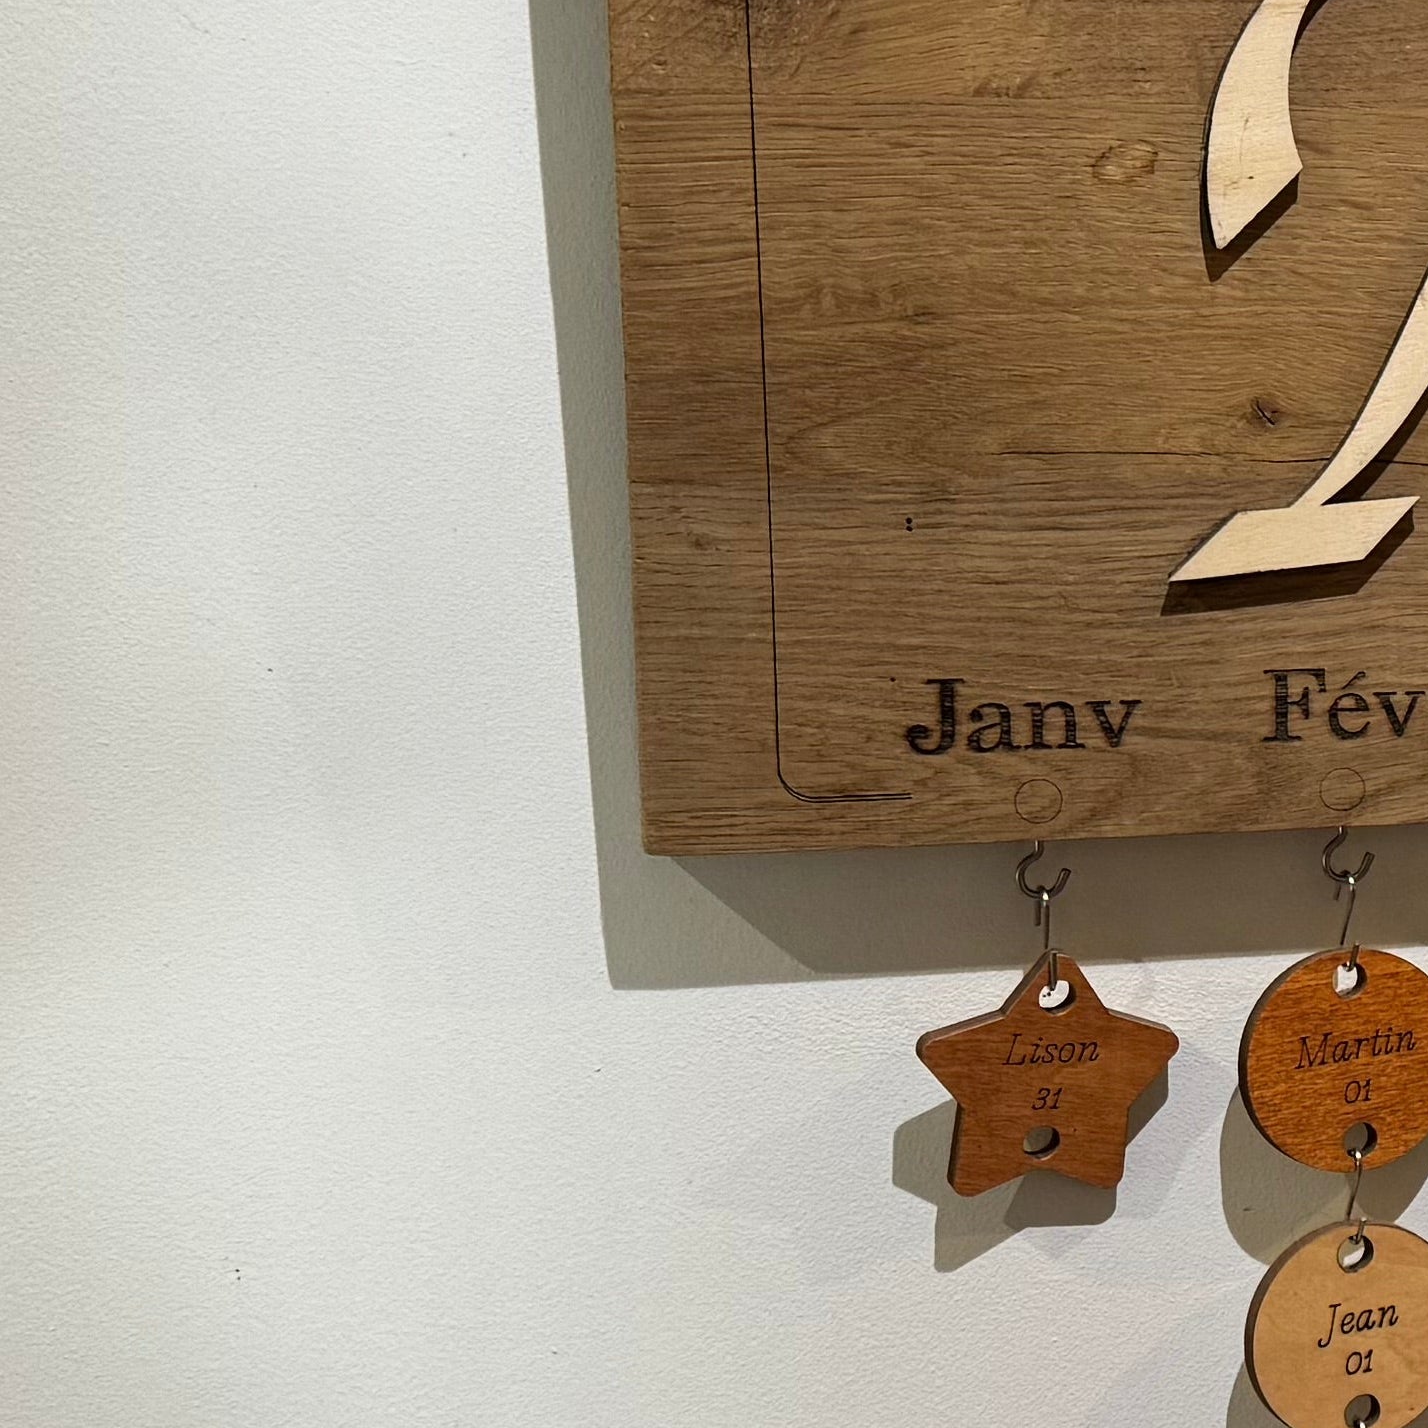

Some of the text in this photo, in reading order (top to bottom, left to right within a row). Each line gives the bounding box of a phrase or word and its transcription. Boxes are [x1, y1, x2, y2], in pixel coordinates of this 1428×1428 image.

[905, 677, 1141, 756] Janv
[1262, 670, 1425, 742] Fév
[1001, 1033, 1101, 1068] Lison
[1295, 1028, 1416, 1070] Martin
[1031, 1087, 1063, 1111] 31
[1343, 1080, 1373, 1104] 01
[1317, 1302, 1399, 1348] Jean
[1345, 1351, 1373, 1376] 01
